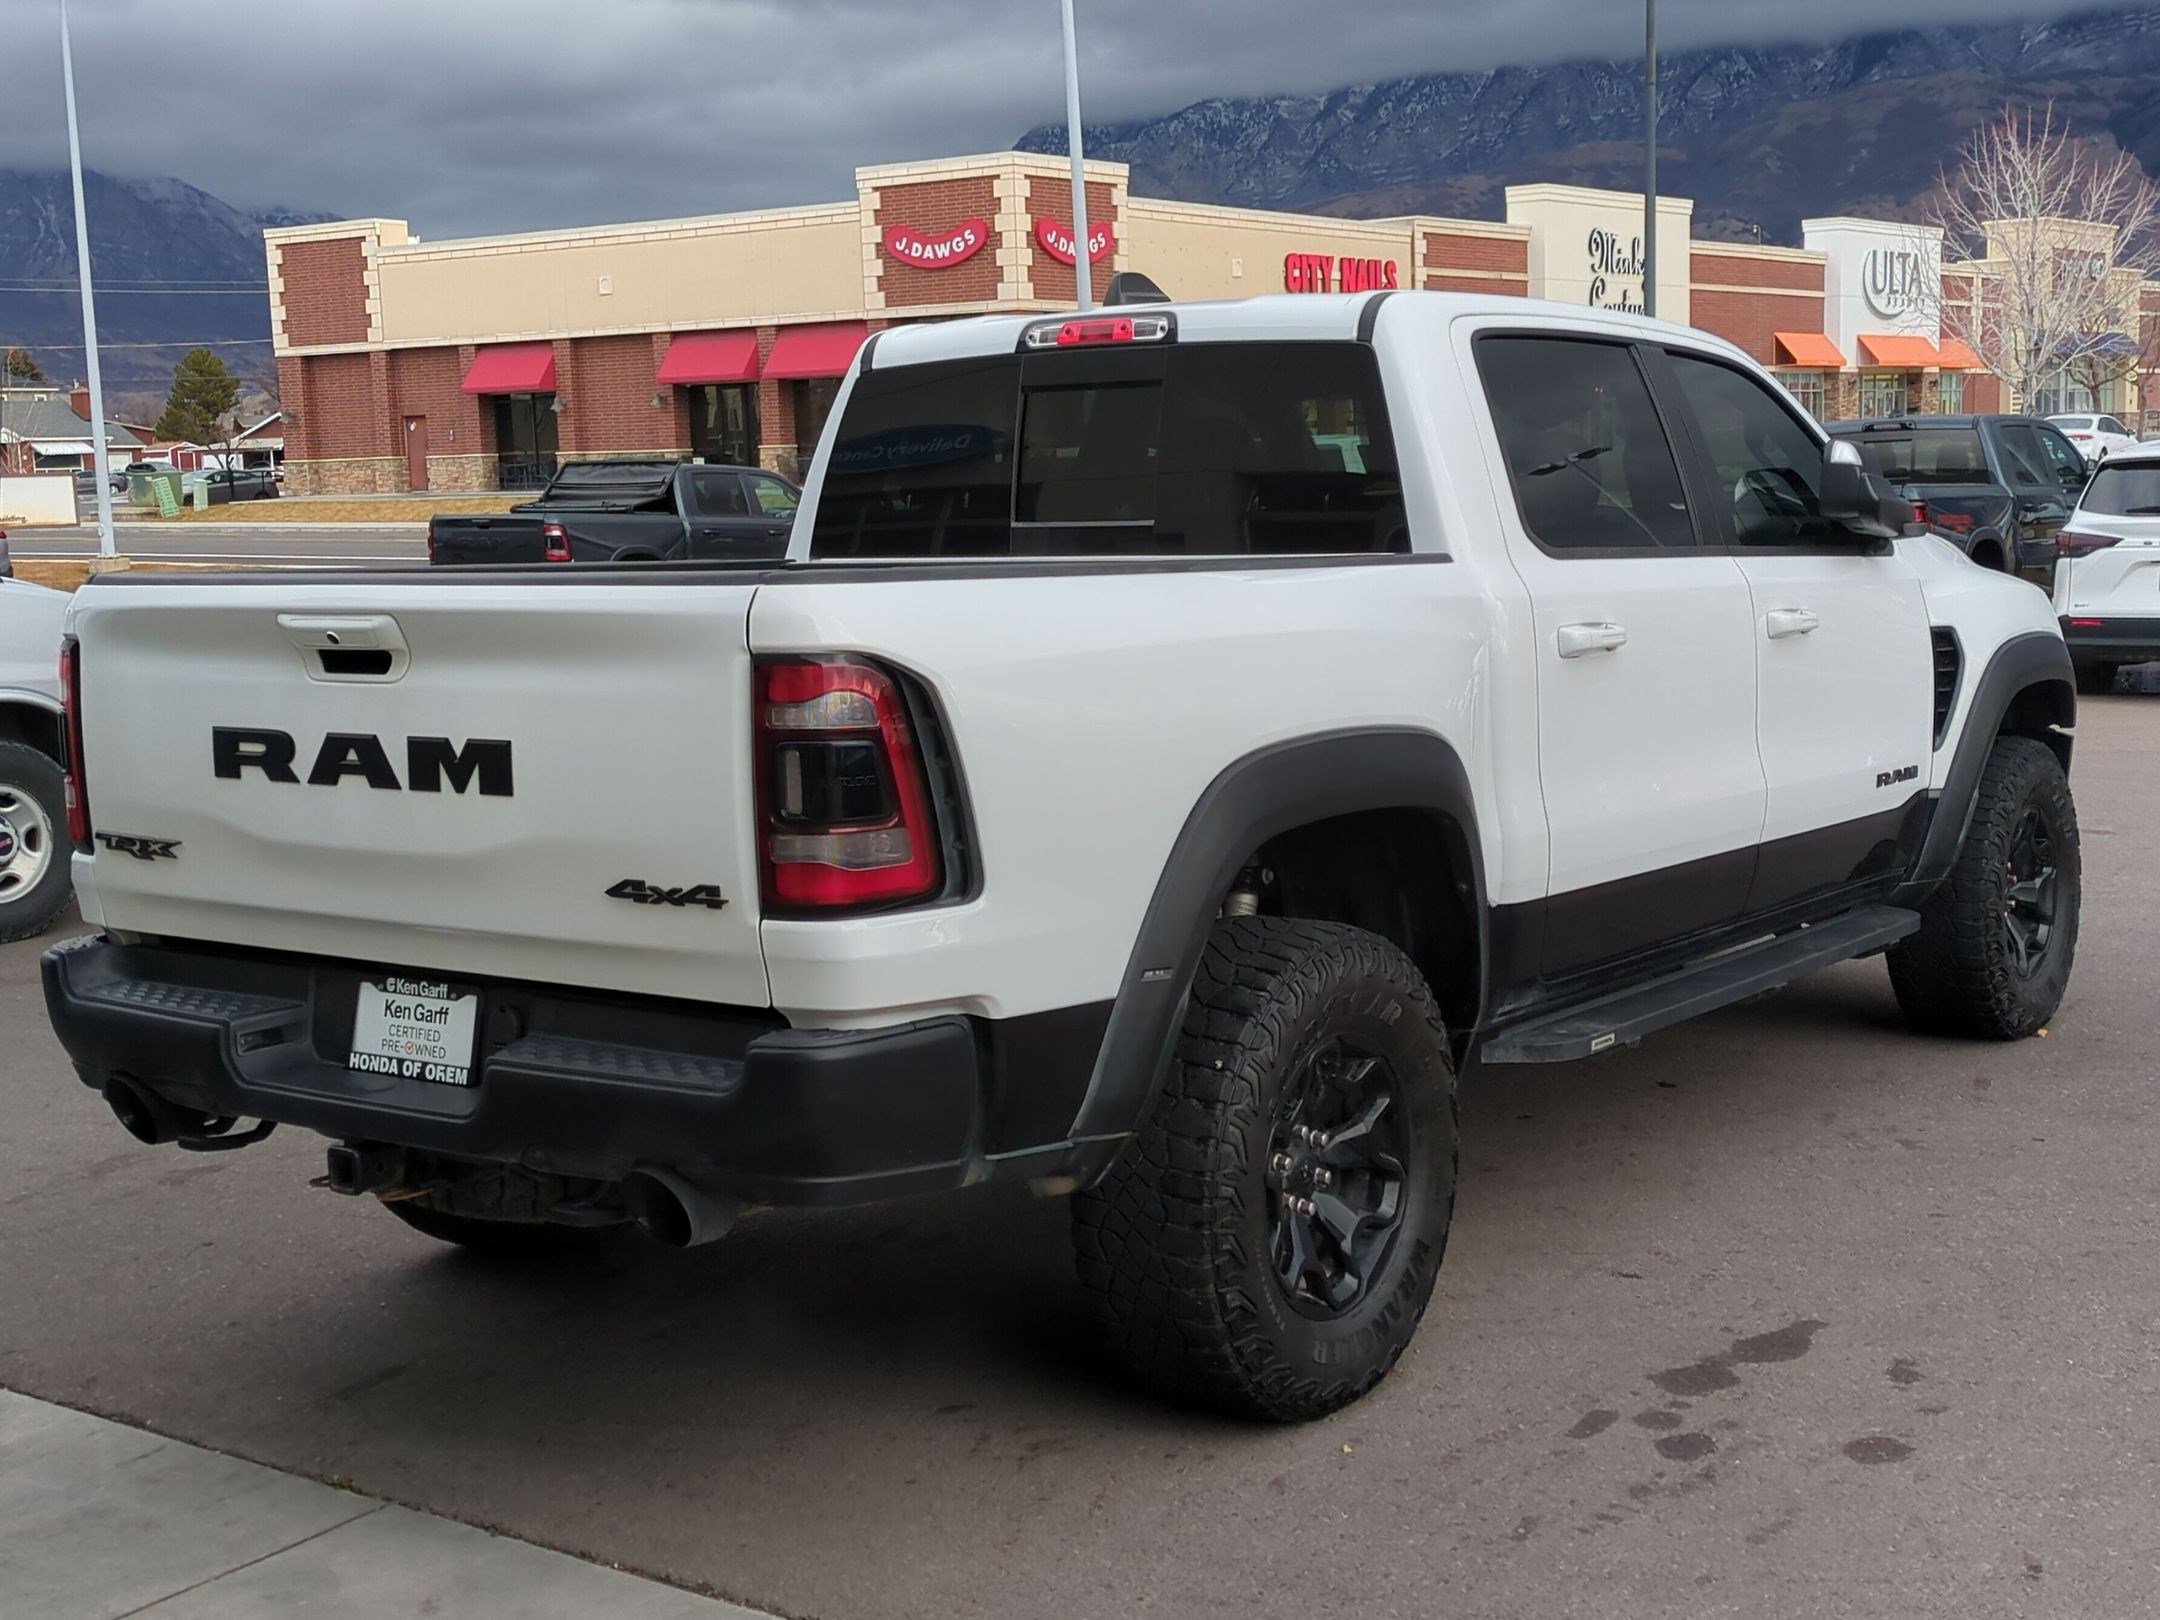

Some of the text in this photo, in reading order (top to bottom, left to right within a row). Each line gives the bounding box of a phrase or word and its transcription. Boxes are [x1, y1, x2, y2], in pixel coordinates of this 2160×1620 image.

[895, 229, 976, 260] J.DAWGS
[1046, 230, 1106, 257] J.DAGS
[1284, 253, 1398, 294] CITY NAILS
[1871, 249, 1922, 296] ULTA
[212, 726, 514, 797] RAM
[1876, 765, 1919, 788] RAM
[95, 831, 183, 861] TRX
[604, 878, 729, 909] 4x4
[396, 979, 448, 999] Ken Garff
[384, 999, 449, 1025] Ken Garff
[388, 1024, 441, 1043] CERTIFIED
[349, 1053, 468, 1085] HONDA OF OREM
